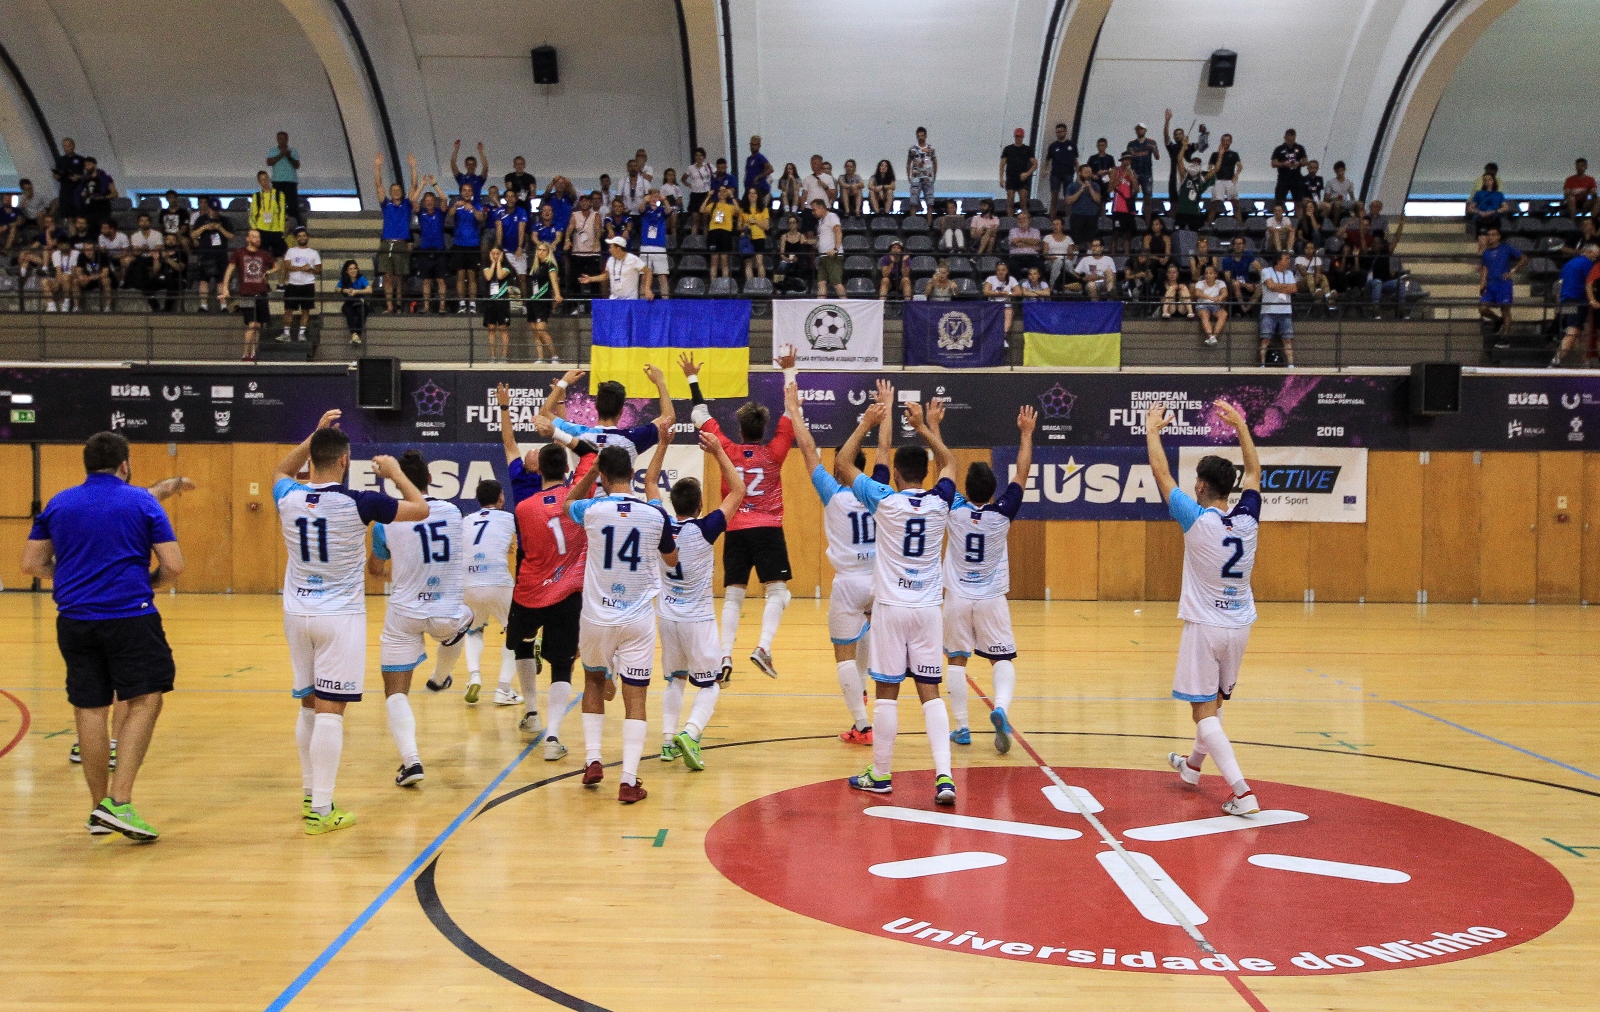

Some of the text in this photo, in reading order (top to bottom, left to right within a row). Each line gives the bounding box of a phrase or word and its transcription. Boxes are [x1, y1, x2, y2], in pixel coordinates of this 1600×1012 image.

[111, 384, 150, 397] EUSA
[487, 388, 544, 398] EOPEAN
[797, 390, 836, 401] EUSA
[1131, 391, 1188, 401] EUROPEAN
[1508, 392, 1549, 405] EUSA
[1109, 408, 1190, 426] FUTAL
[1130, 425, 1212, 436] CHPIONSHIP
[1316, 426, 1345, 437] 2019
[1007, 462, 1163, 504] EUSA
[1272, 495, 1282, 505] of
[1284, 495, 1309, 506] Sport
[295, 516, 329, 563] 11
[472, 519, 490, 546] 7
[547, 516, 567, 556] 1
[848, 511, 876, 545] 10
[903, 517, 926, 558] 8
[414, 520, 450, 564] 15
[601, 525, 642, 572] 14
[965, 532, 986, 564] 9
[1220, 535, 1245, 579] 2
[316, 677, 357, 691] uma.es
[881, 916, 1509, 972] Universidade do Minho
